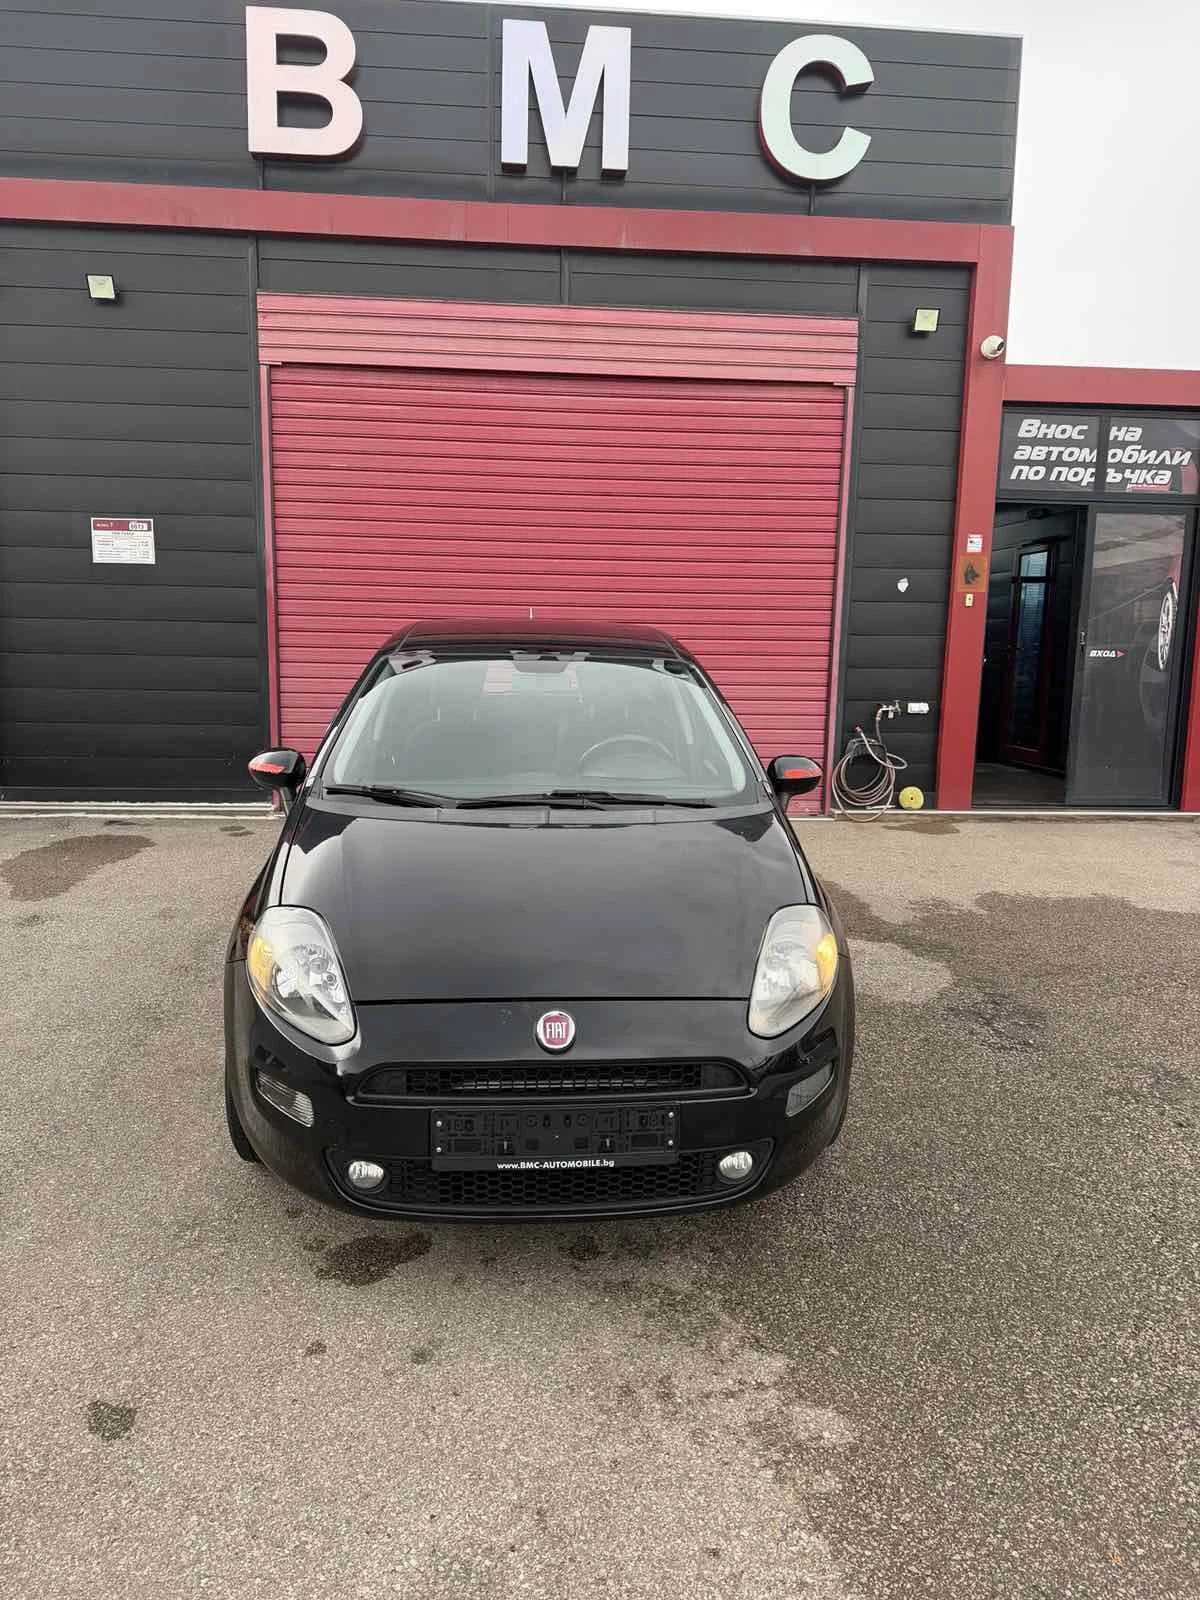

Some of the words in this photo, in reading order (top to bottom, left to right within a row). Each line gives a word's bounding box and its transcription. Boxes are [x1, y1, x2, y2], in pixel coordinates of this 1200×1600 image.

[246, 5, 363, 160] B
[501, 19, 632, 177] M
[758, 34, 874, 184] C
[1017, 418, 1089, 440] Внос
[1109, 426, 1143, 442] на
[1013, 444, 1193, 466] автомобили
[1010, 465, 1047, 481] по
[1050, 466, 1172, 487] поръчка
[546, 1022, 568, 1039] FIAT
[497, 1159, 615, 1169] www.BMC-AUTOMOBILE.bg
